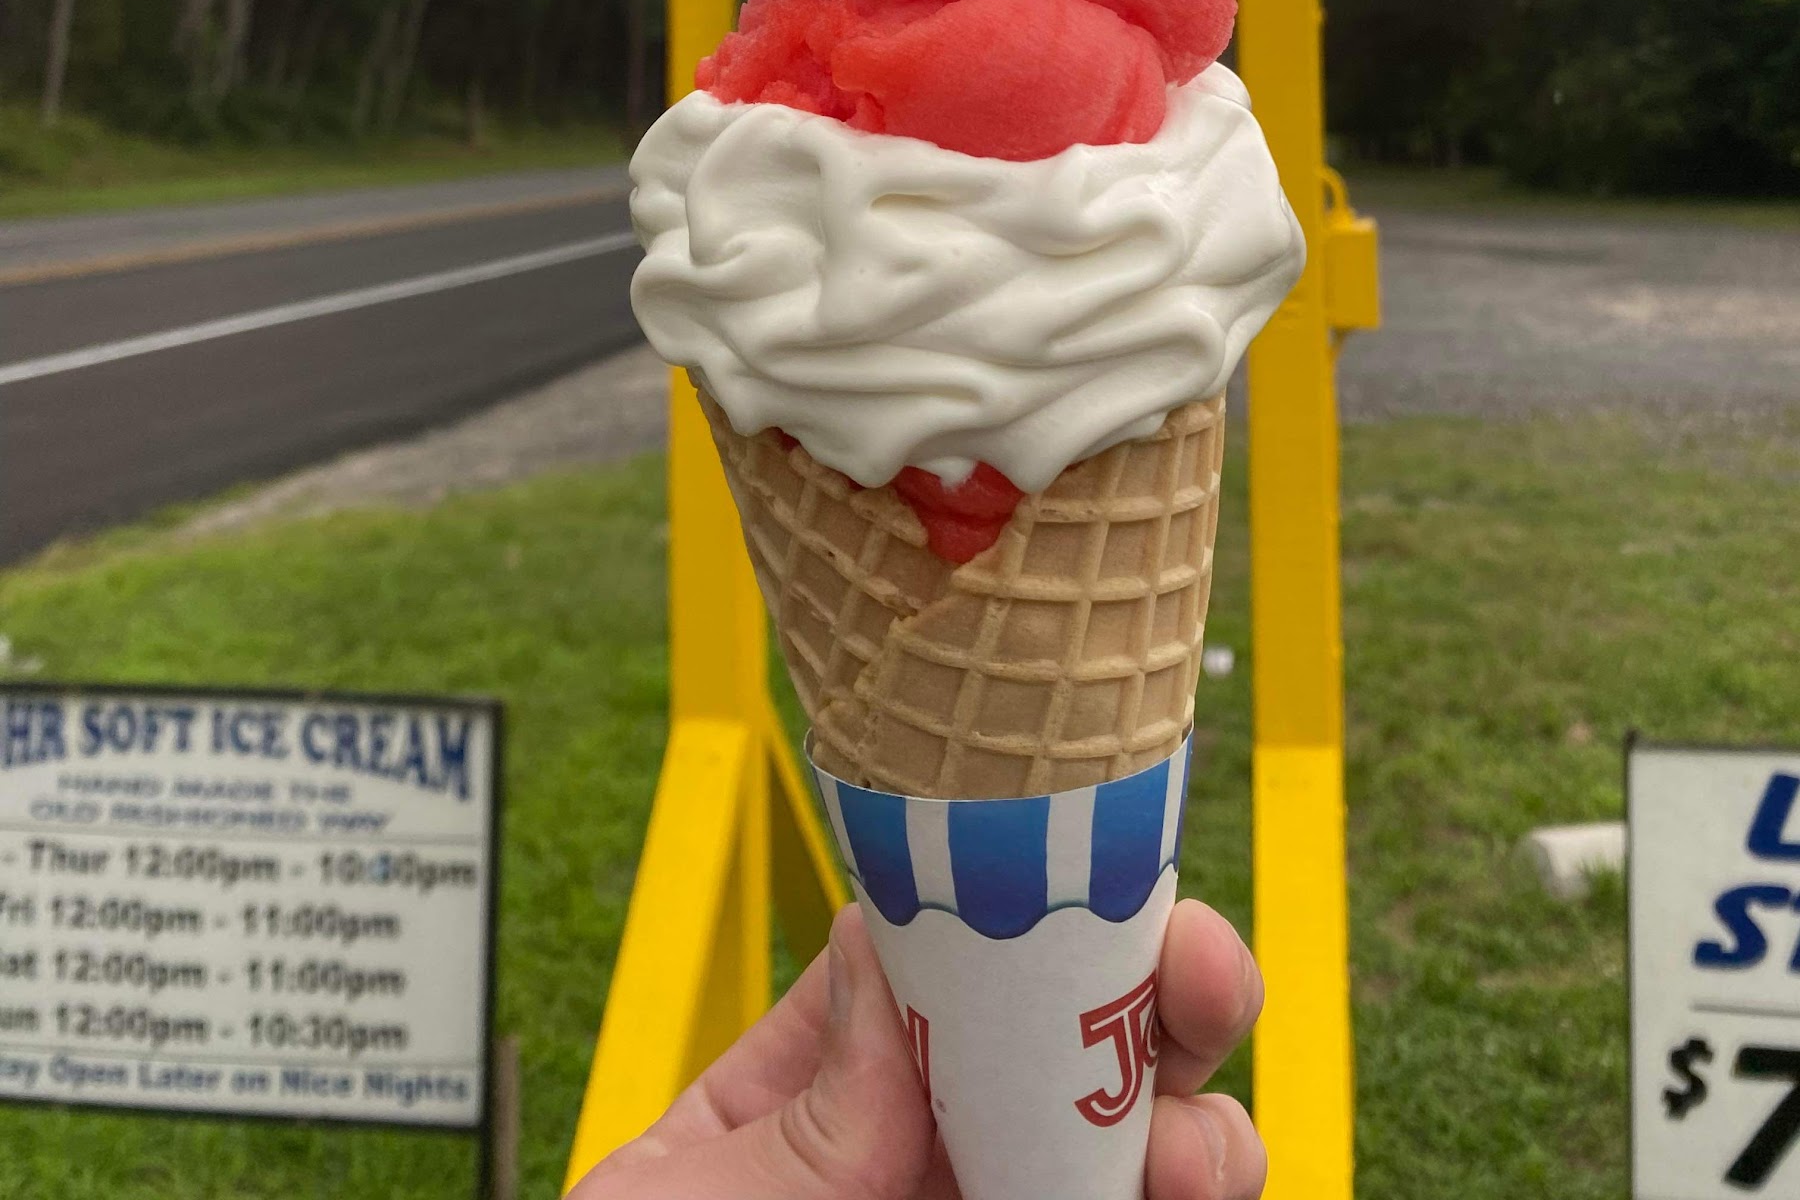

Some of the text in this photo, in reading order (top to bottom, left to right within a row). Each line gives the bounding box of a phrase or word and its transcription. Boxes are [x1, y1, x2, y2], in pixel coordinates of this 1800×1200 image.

[81, 705, 196, 757] SOFT
[213, 710, 290, 759] ICE
[302, 712, 471, 802] CREAM
[27, 839, 110, 874] Thur
[126, 846, 279, 889] 12:00pm
[52, 897, 202, 939] 12:00pm
[242, 904, 401, 947] 11:00pm
[55, 951, 206, 993] 12:00pm
[247, 958, 406, 1001] 11:00pm
[56, 1003, 210, 1048] 12:00pm
[250, 1013, 410, 1058] 10:30pm
[50, 1055, 127, 1090] Open
[138, 1062, 220, 1091] Later
[281, 1069, 352, 1097] Nice
[366, 1071, 469, 1107] Nights
